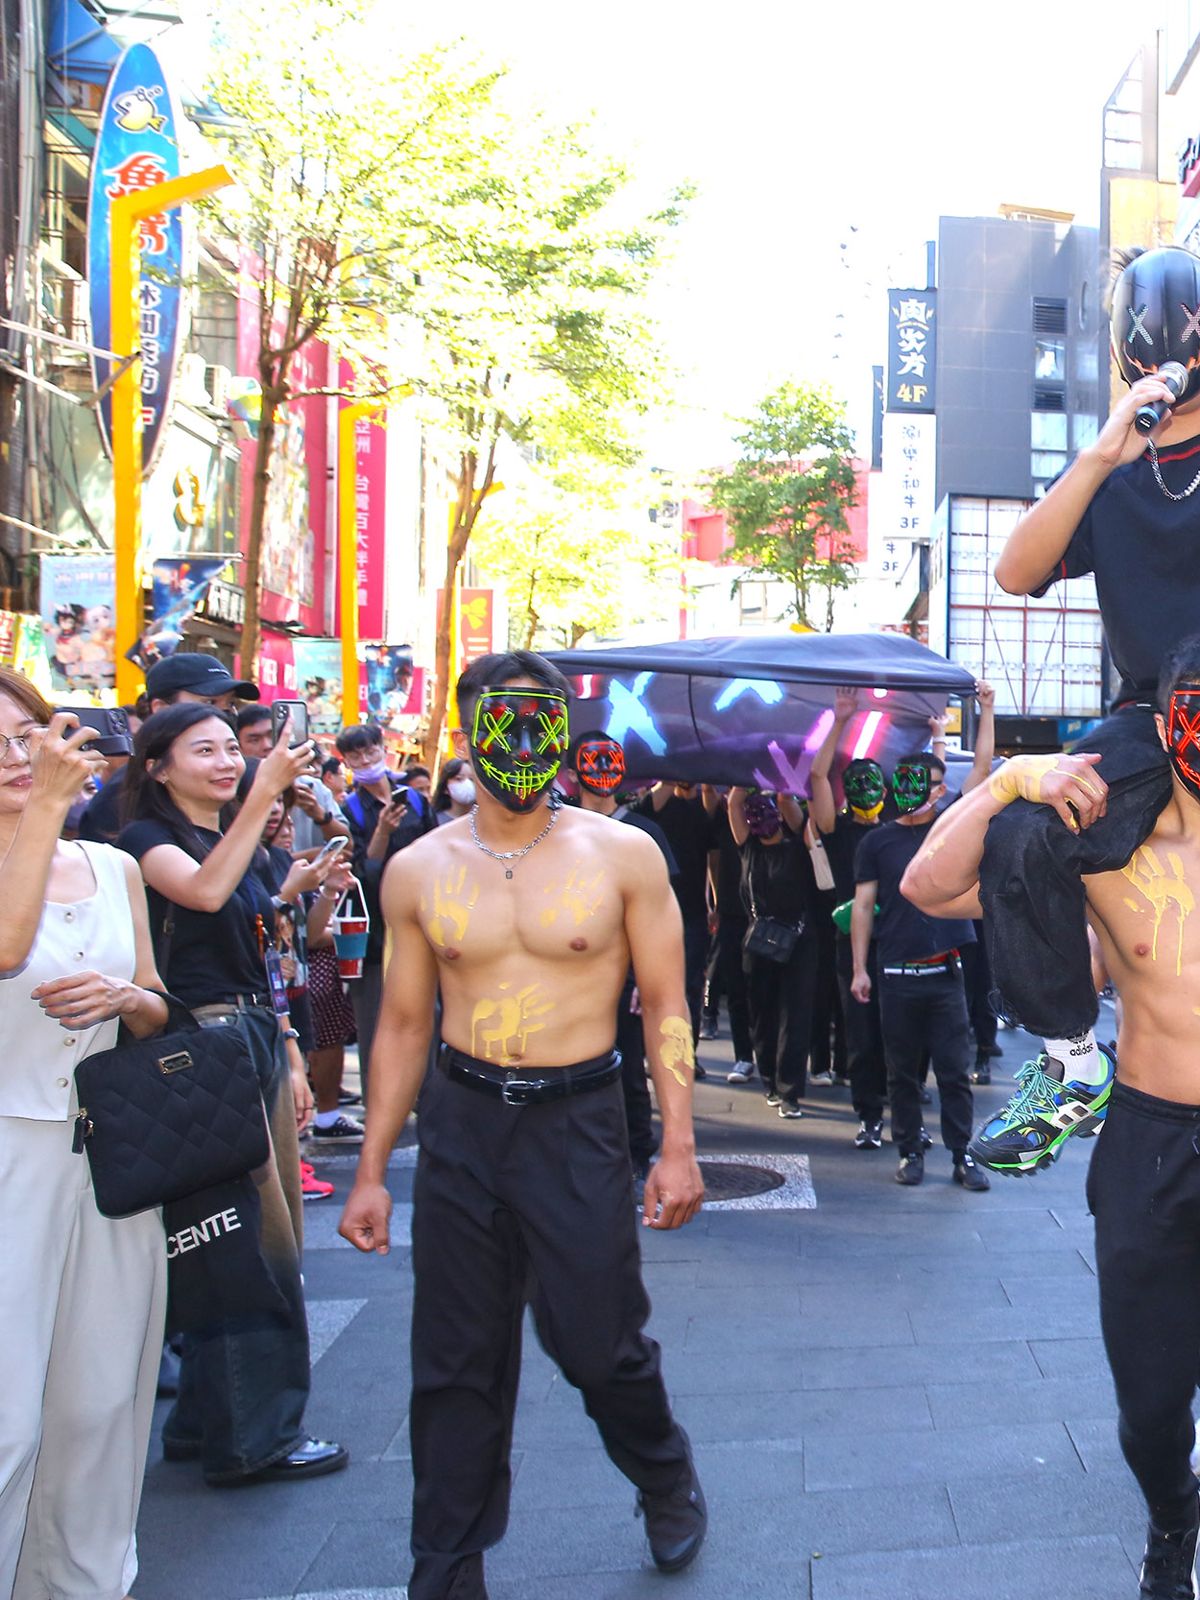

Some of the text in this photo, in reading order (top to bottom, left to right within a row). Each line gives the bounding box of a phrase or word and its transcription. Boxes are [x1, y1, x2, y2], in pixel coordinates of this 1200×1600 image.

[896, 383, 928, 403] 4F
[900, 517, 919, 529] 3F
[882, 561, 899, 572] 3F
[1070, 1043, 1093, 1056] adidas
